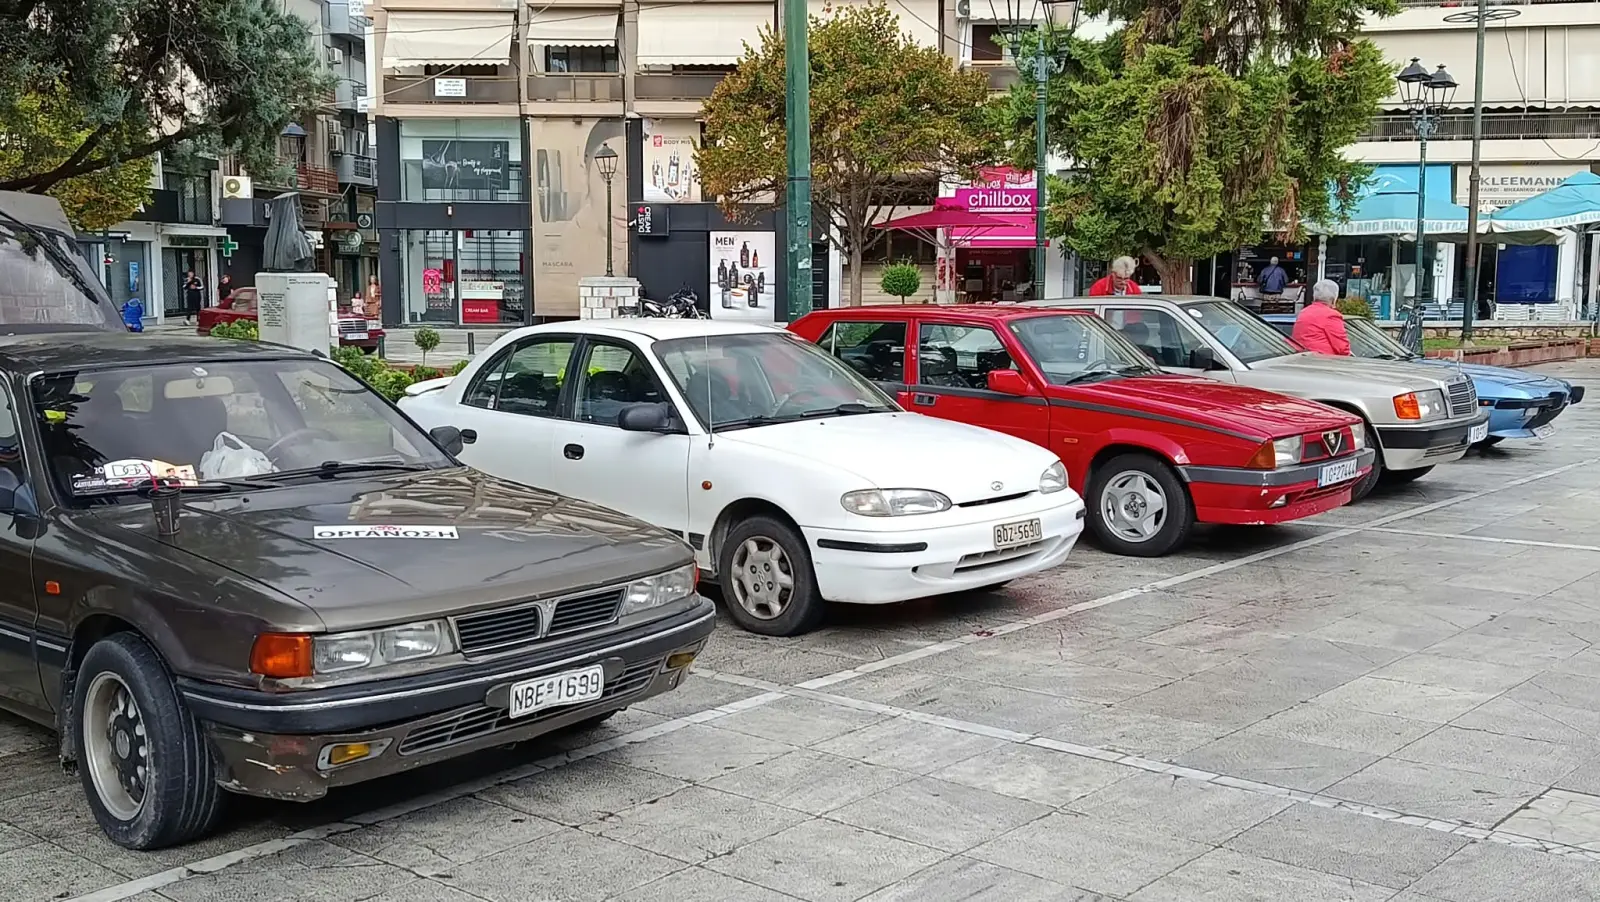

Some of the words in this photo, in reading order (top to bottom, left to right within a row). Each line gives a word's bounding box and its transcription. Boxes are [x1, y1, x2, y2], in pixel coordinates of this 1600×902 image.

[968, 190, 1032, 207] chillbox
[1382, 220, 1444, 231] ΒΙΟΛΟΙΚΟ
[715, 236, 735, 246] MEN
[316, 530, 455, 538] ΟΡΓΑΝΩΣΗ
